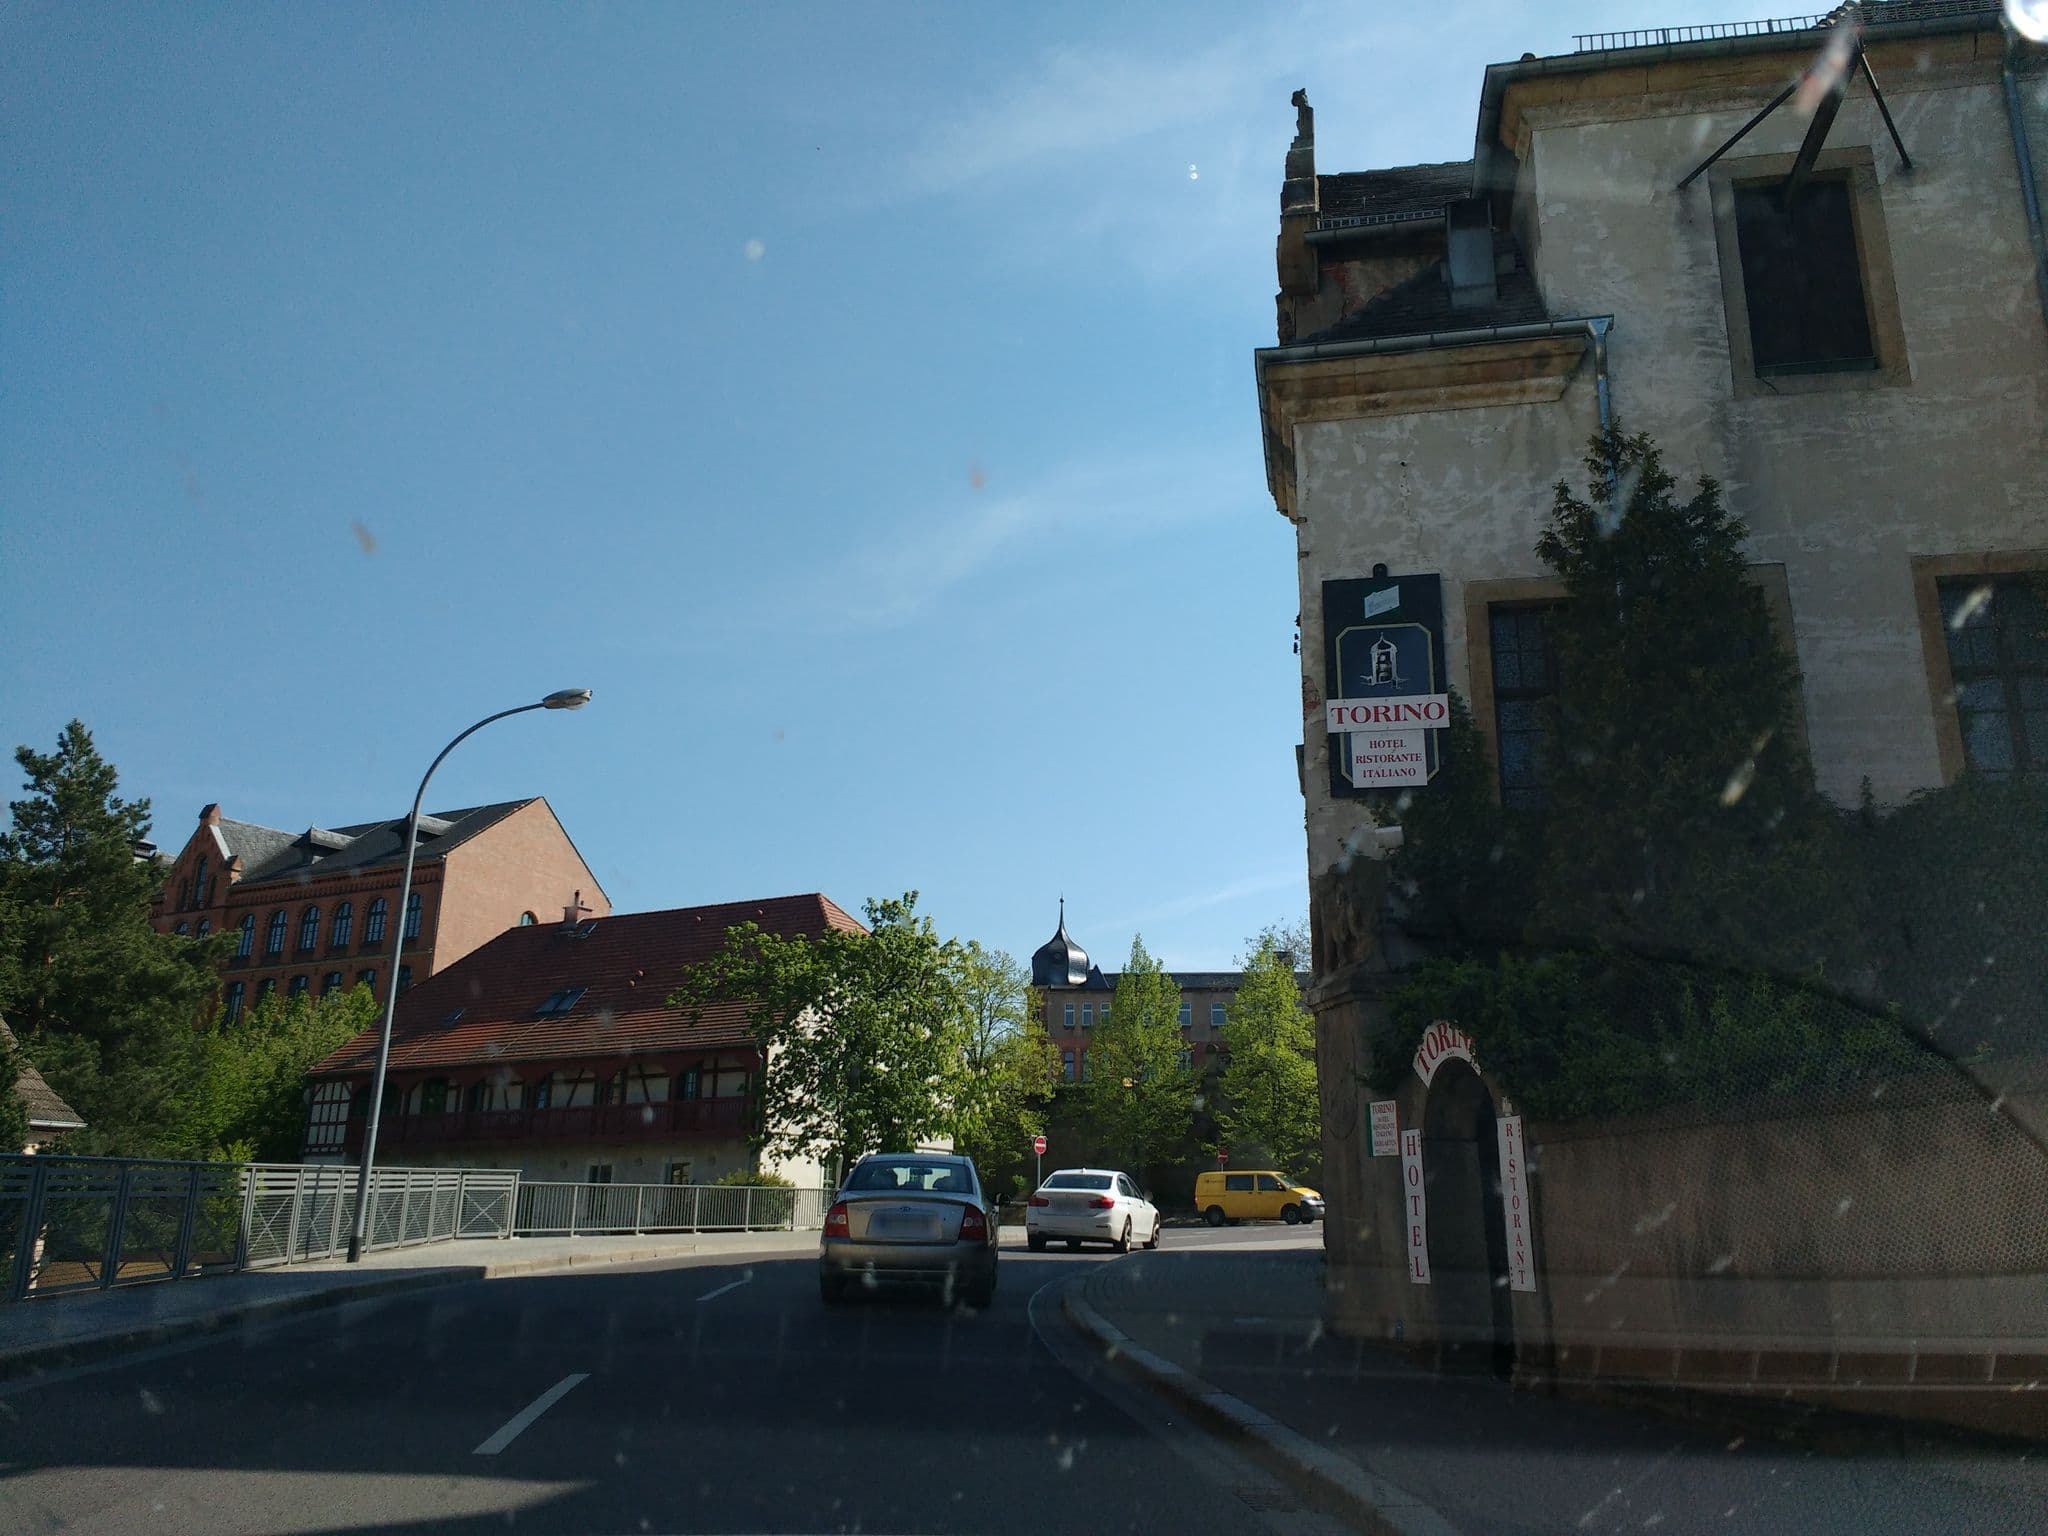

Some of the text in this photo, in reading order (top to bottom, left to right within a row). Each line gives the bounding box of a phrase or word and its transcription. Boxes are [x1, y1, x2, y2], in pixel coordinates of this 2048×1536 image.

[1330, 702, 1445, 725] TORINO
[1369, 739, 1407, 749] HOTEL
[1355, 753, 1422, 764] RISTORANTE
[1363, 768, 1417, 778] ITALIANO
[1417, 1023, 1473, 1073] TORIN
[1405, 1135, 1425, 1278] HOTEL
[1505, 1123, 1526, 1285] RISTORANT
